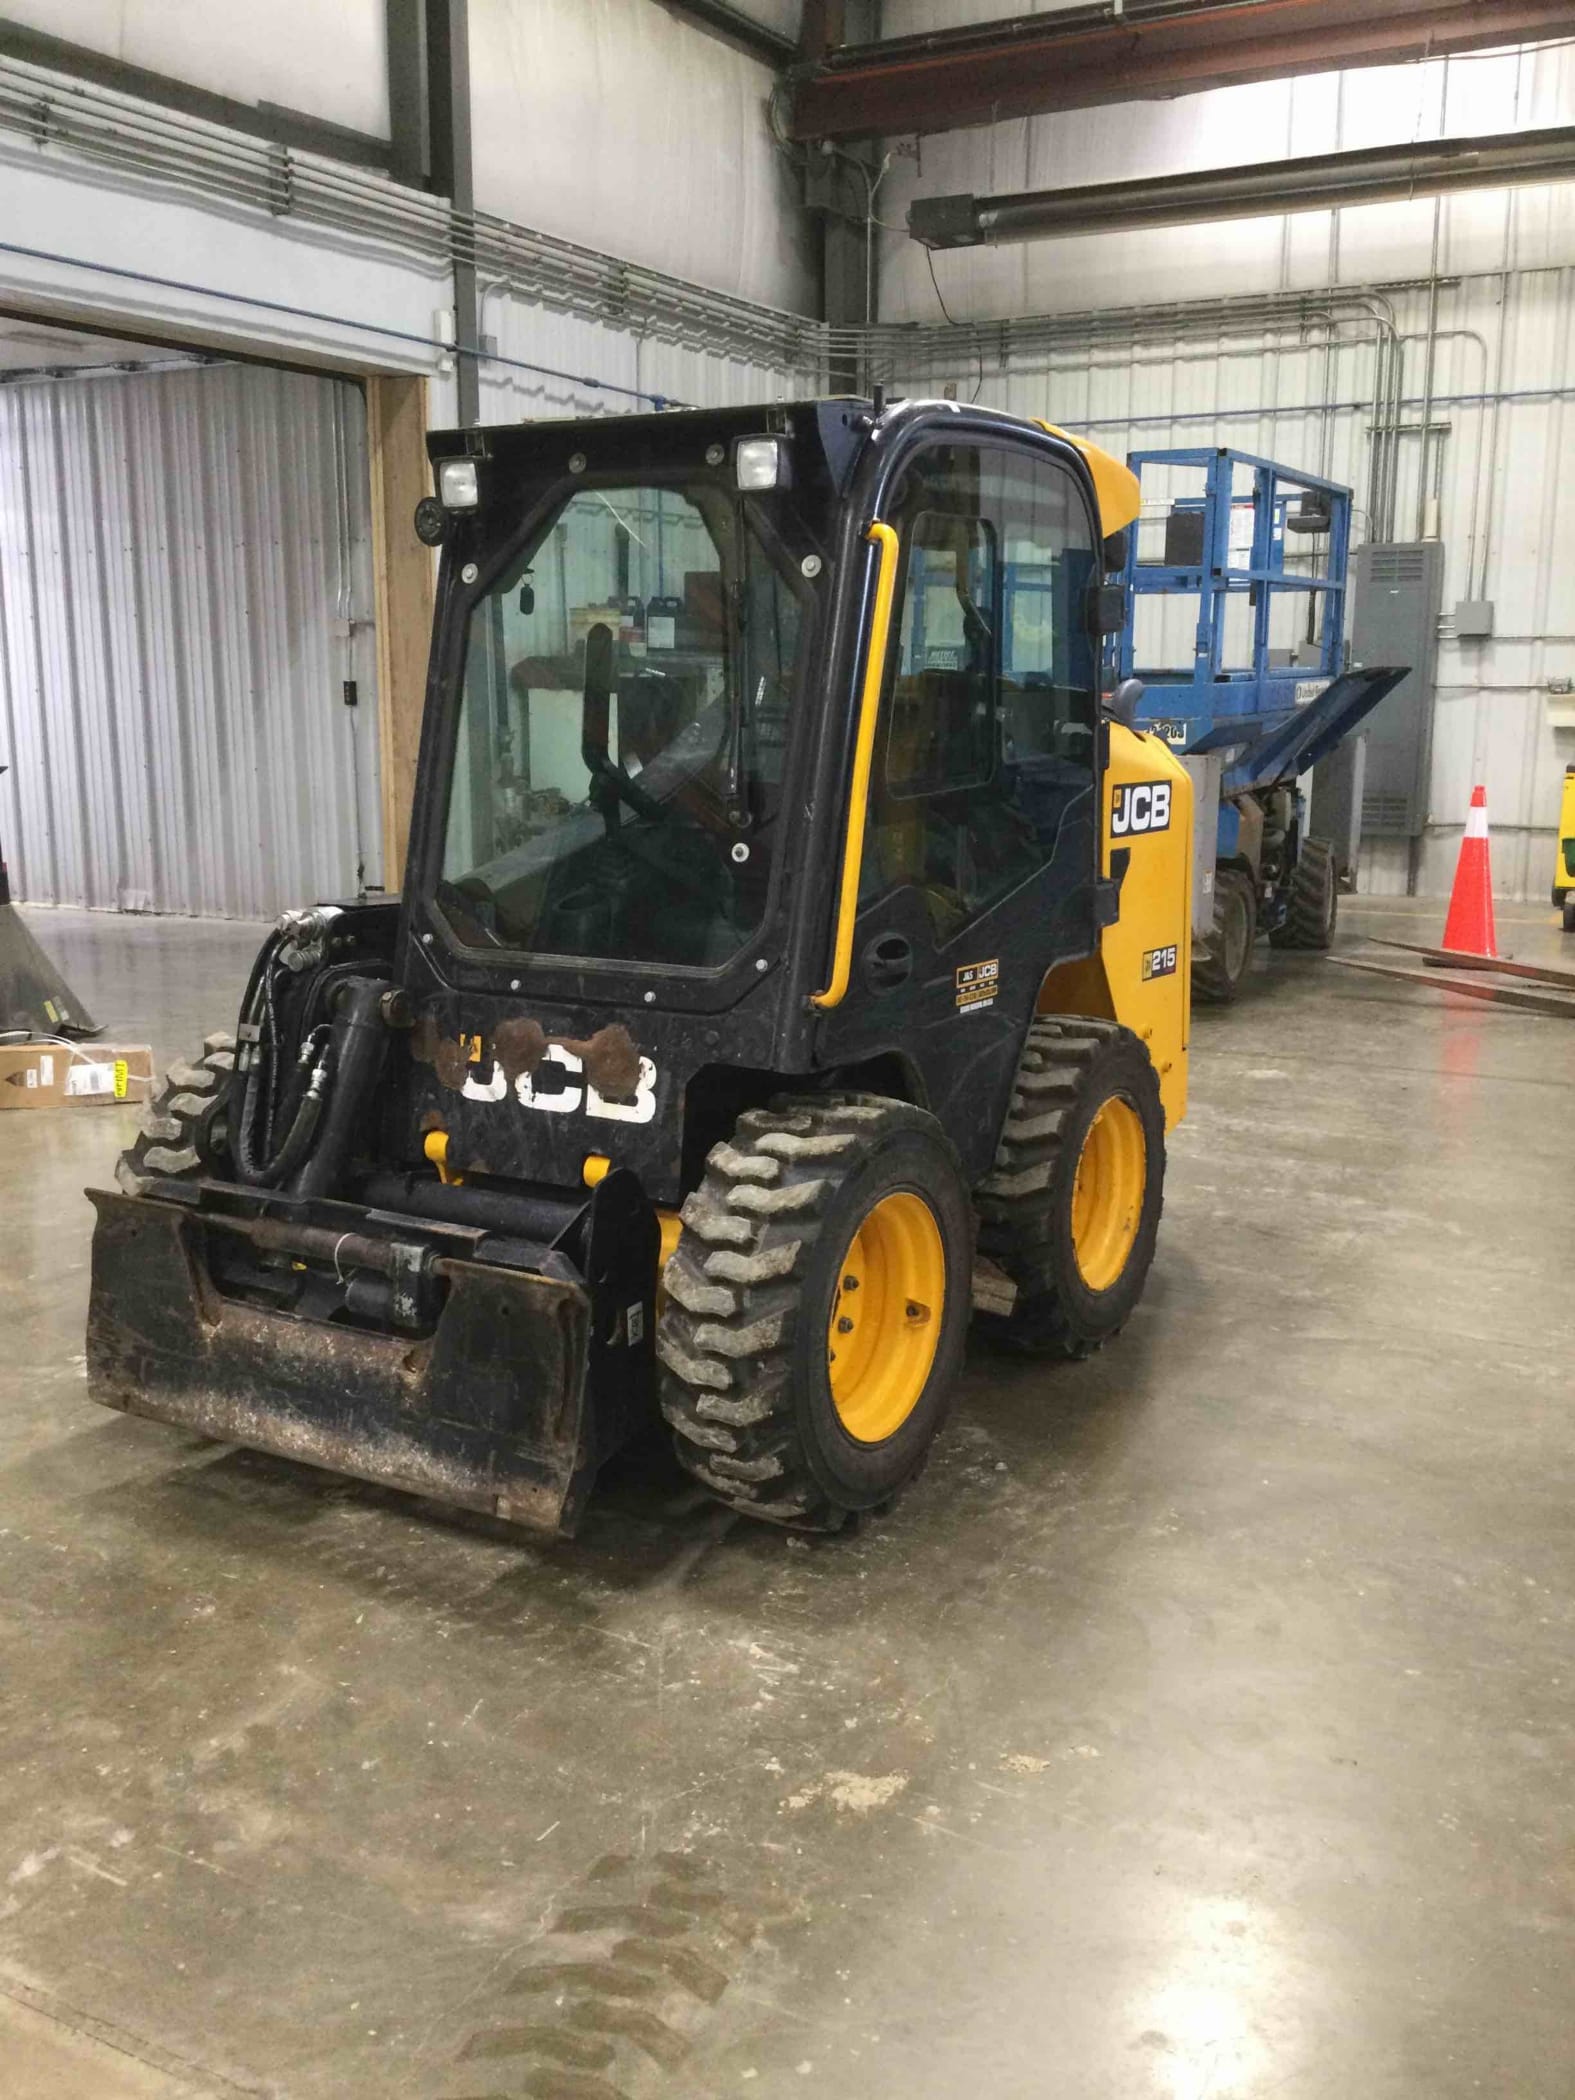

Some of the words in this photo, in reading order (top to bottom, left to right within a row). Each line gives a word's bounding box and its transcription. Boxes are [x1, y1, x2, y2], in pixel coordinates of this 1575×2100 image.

[1112, 784, 1171, 834] JCB
[1152, 947, 1176, 970] 215
[979, 964, 997, 978] JCB
